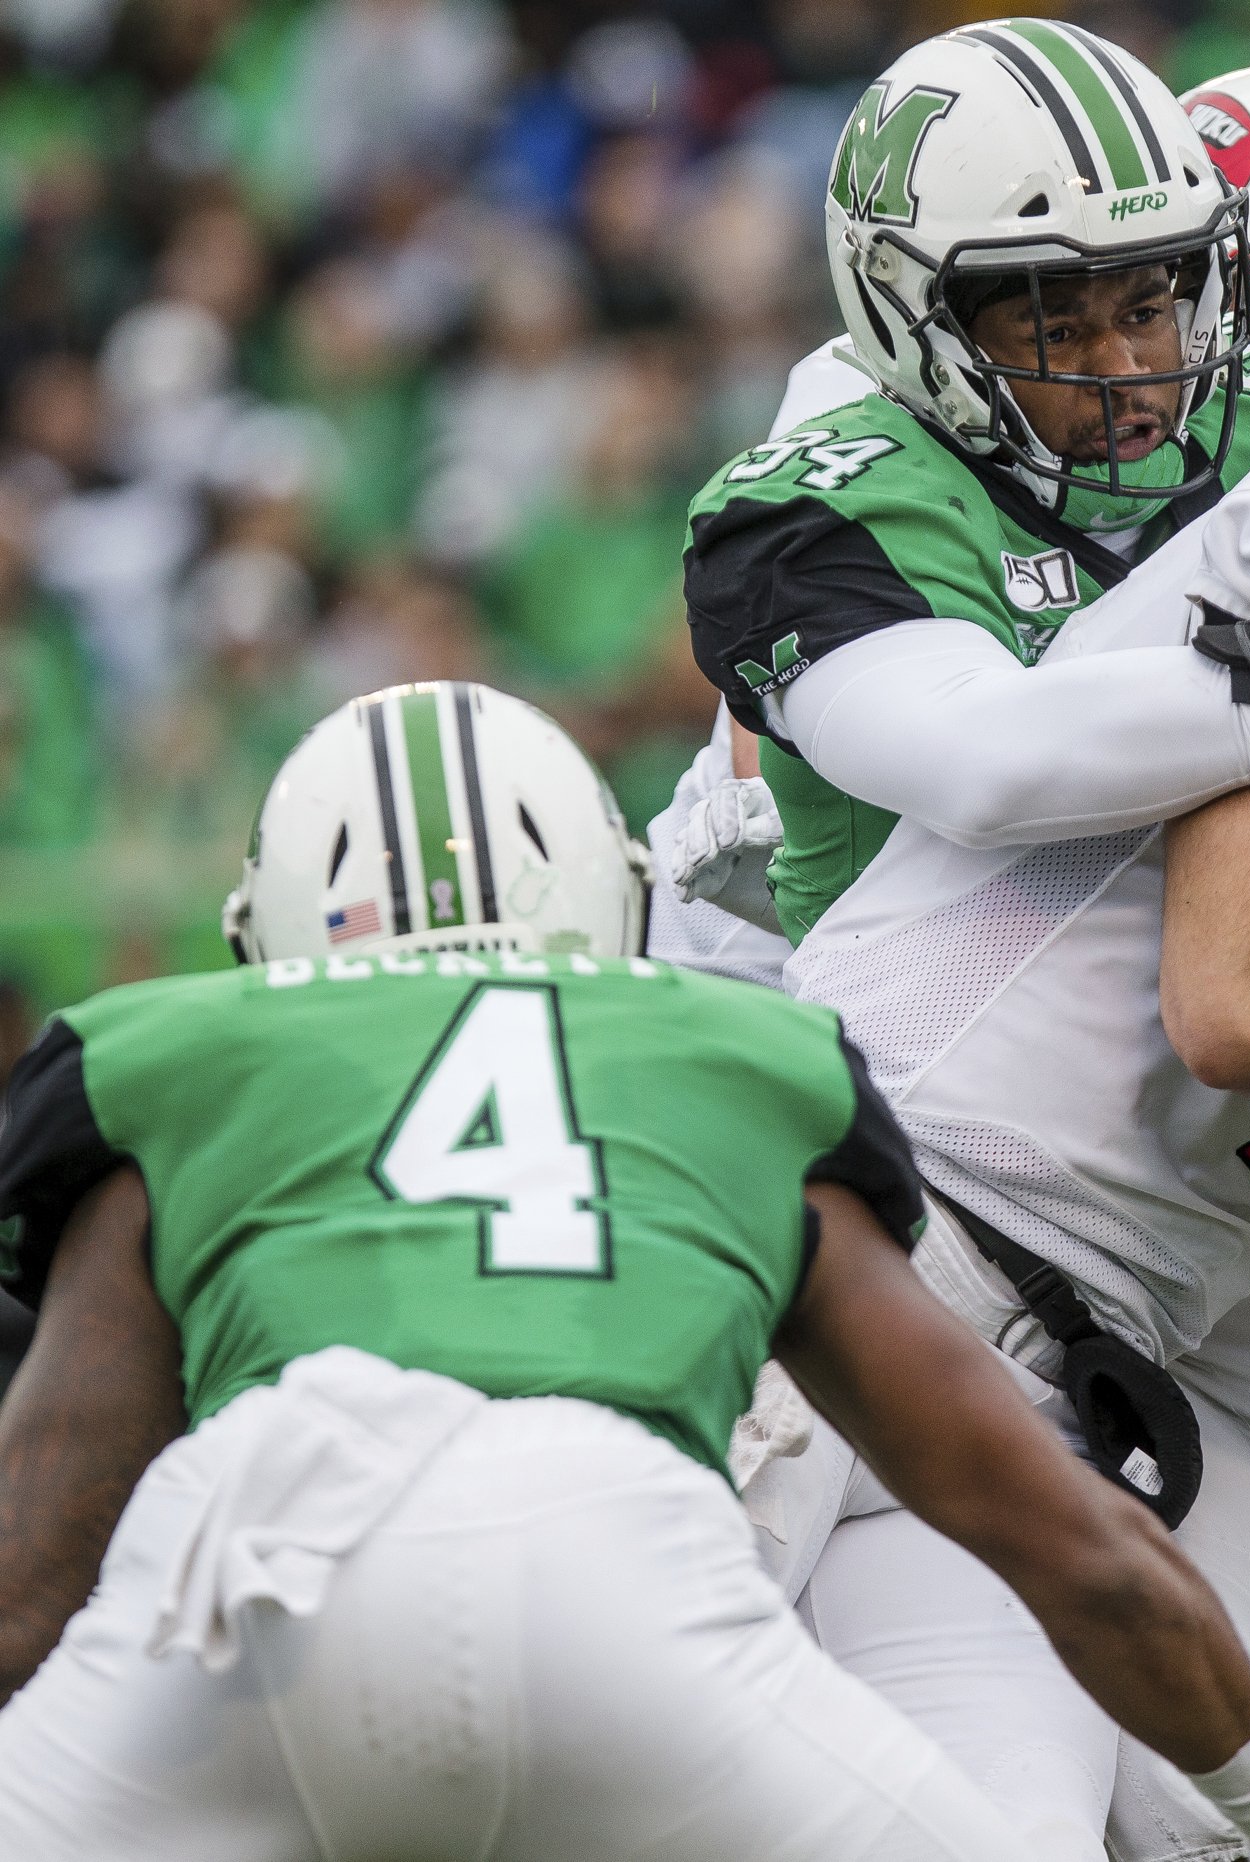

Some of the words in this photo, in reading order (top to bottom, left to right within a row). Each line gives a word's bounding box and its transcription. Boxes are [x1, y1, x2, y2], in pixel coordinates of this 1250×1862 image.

[829, 79, 961, 229] M
[1108, 190, 1169, 222] HERD
[723, 428, 906, 491] 94
[1003, 549, 1079, 609] 150
[752, 679, 778, 696] THE
[777, 658, 810, 684] HERD
[368, 981, 616, 1282] 4
